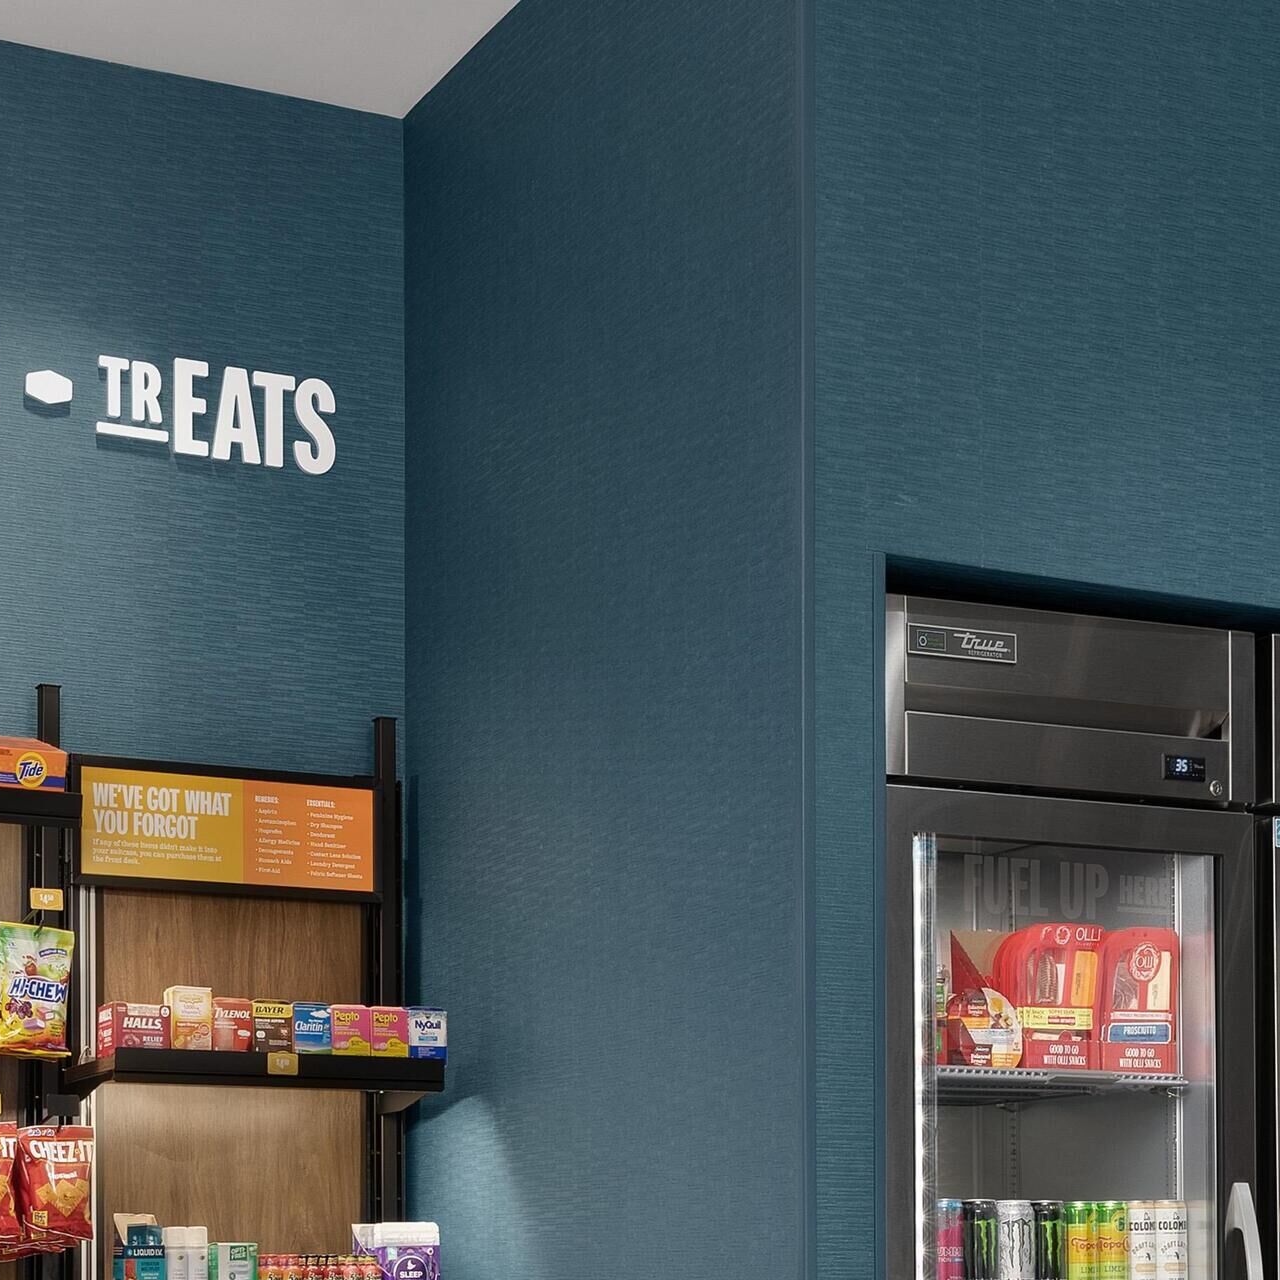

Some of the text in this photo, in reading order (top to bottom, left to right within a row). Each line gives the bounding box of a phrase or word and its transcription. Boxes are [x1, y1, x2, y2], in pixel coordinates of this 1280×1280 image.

[96, 354, 336, 475] TREATS
[1176, 759, 1188, 772] 35
[92, 782, 232, 816] WE'VE GOT WHAT
[92, 808, 198, 840] YOU FORGOT
[1060, 861, 1109, 920] UP
[1076, 927, 1101, 942] OLLI
[214, 1008, 250, 1019] TYLENOL
[334, 1011, 359, 1021] Pepto
[373, 1012, 398, 1023] Pepto
[295, 1021, 323, 1033] Claritin
[415, 1020, 441, 1031] NyQuil
[1124, 1026, 1157, 1036] PROSCIUTTO
[1050, 1045, 1079, 1054] GOOD TO GO
[1044, 1055, 1086, 1065] WITH OLLI SNACKS
[399, 1271, 423, 1279] SLEEP
